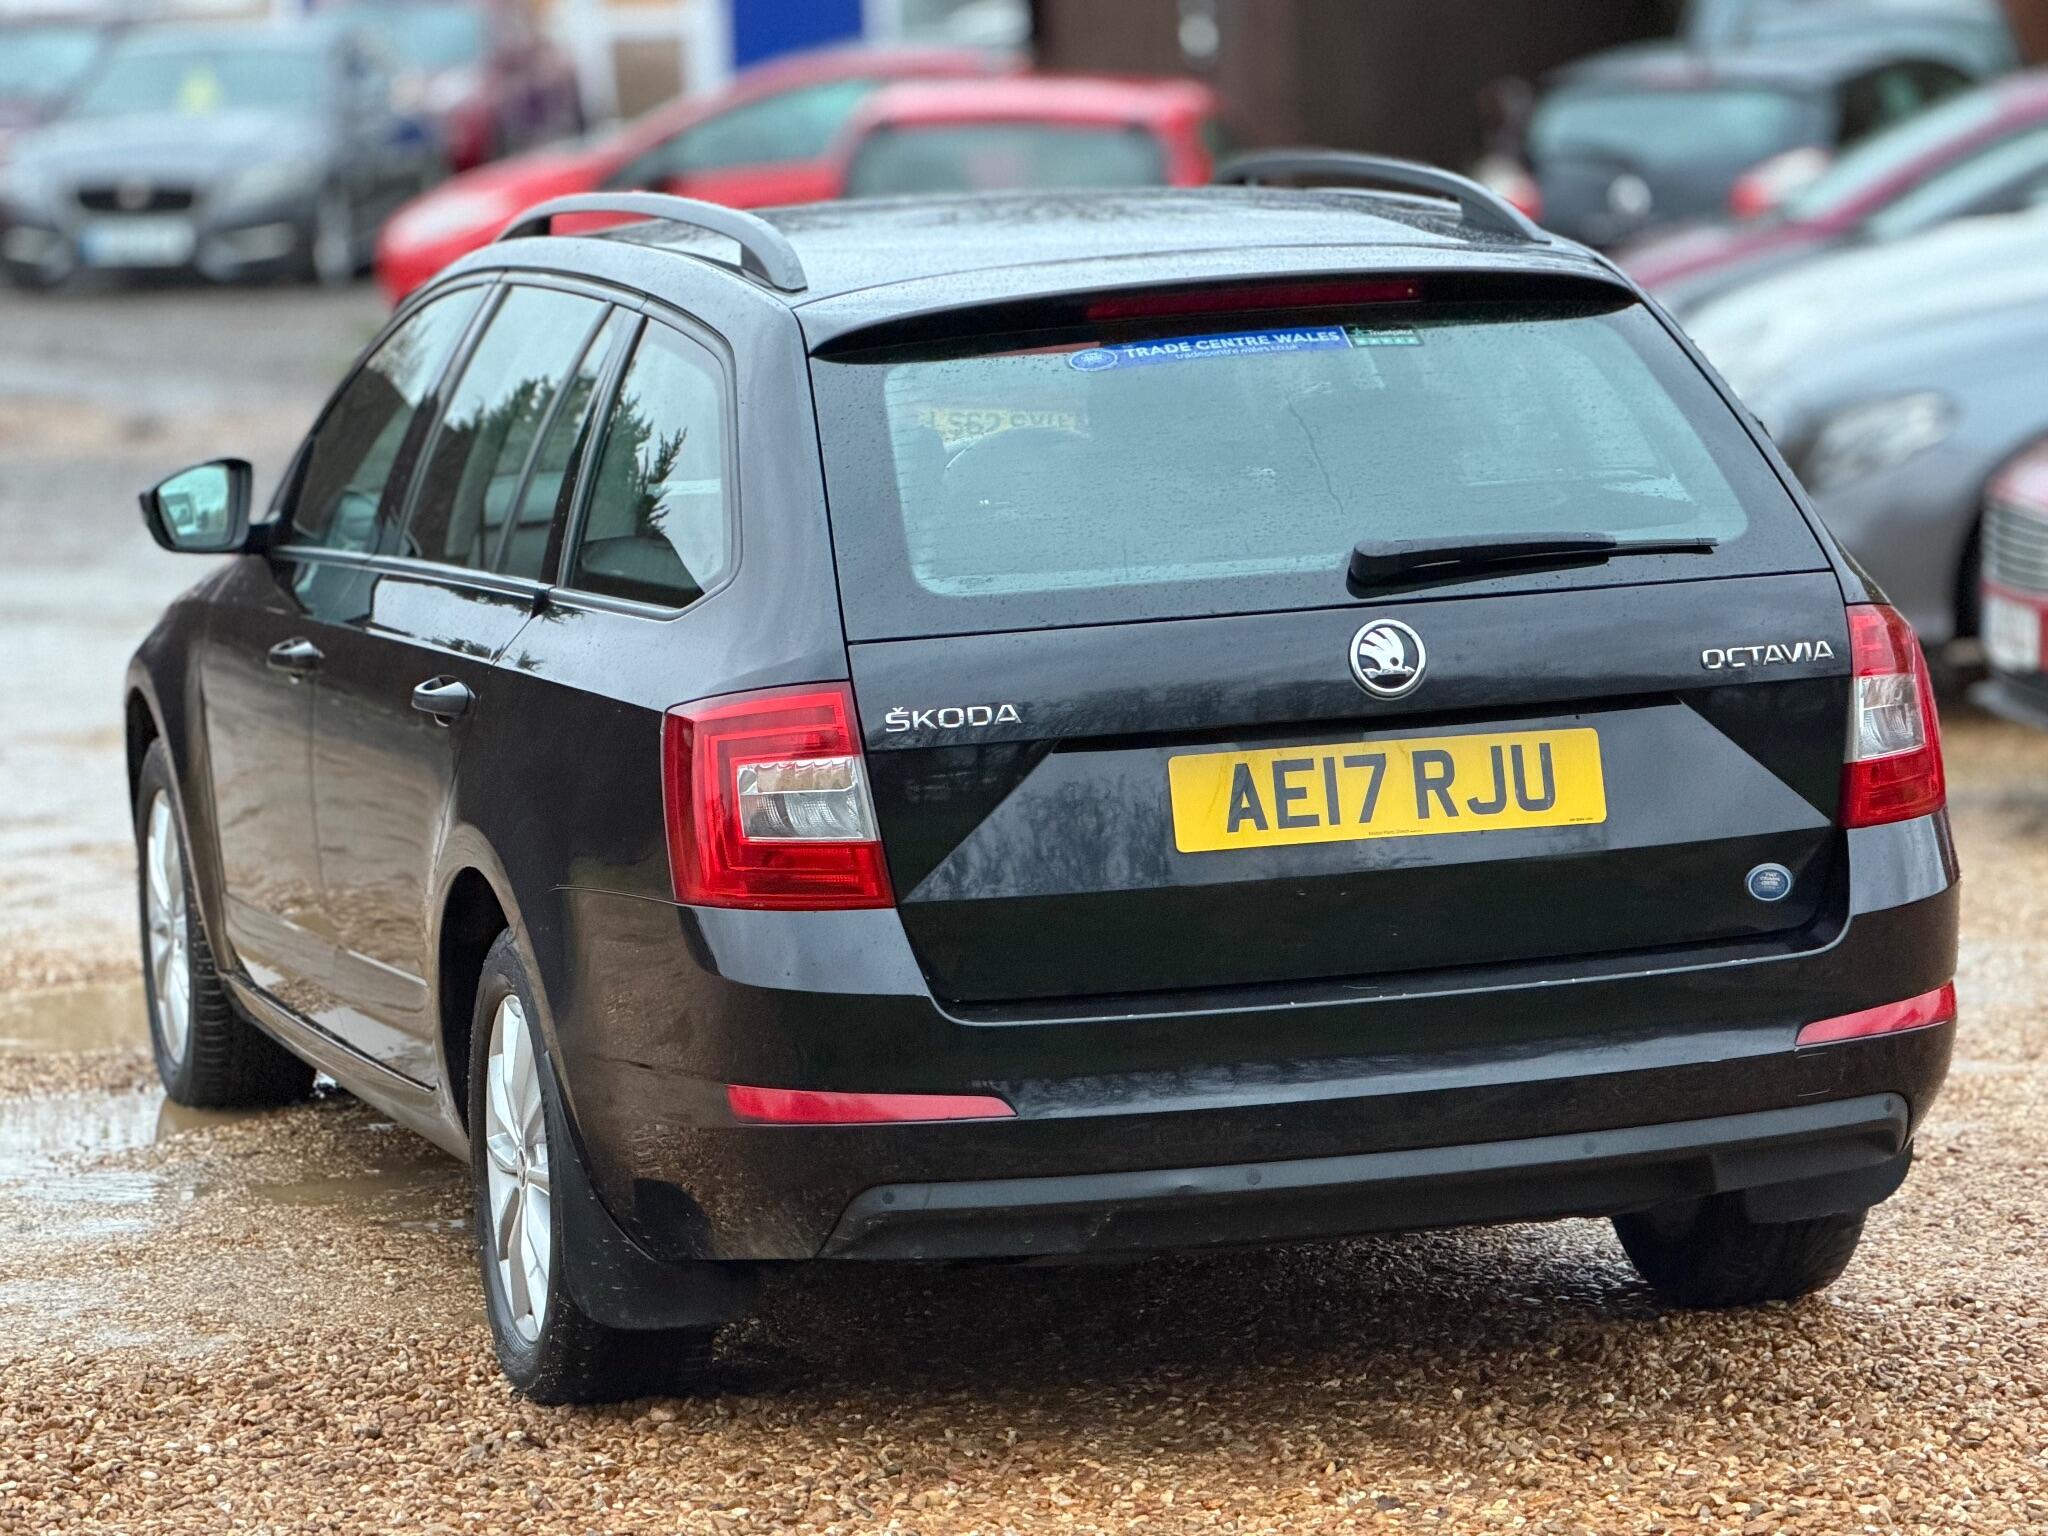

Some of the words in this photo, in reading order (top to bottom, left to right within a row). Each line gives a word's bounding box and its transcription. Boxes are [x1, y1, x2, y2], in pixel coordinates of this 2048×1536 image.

[1124, 342, 1191, 359] TRADE
[1195, 335, 1271, 351] CENTRE
[1272, 331, 1341, 345] WALES
[1702, 640, 1835, 669] OCTAVIA
[885, 704, 1023, 732] ŠKODA
[1226, 753, 1387, 833] AE17
[1411, 742, 1557, 820] RJU
